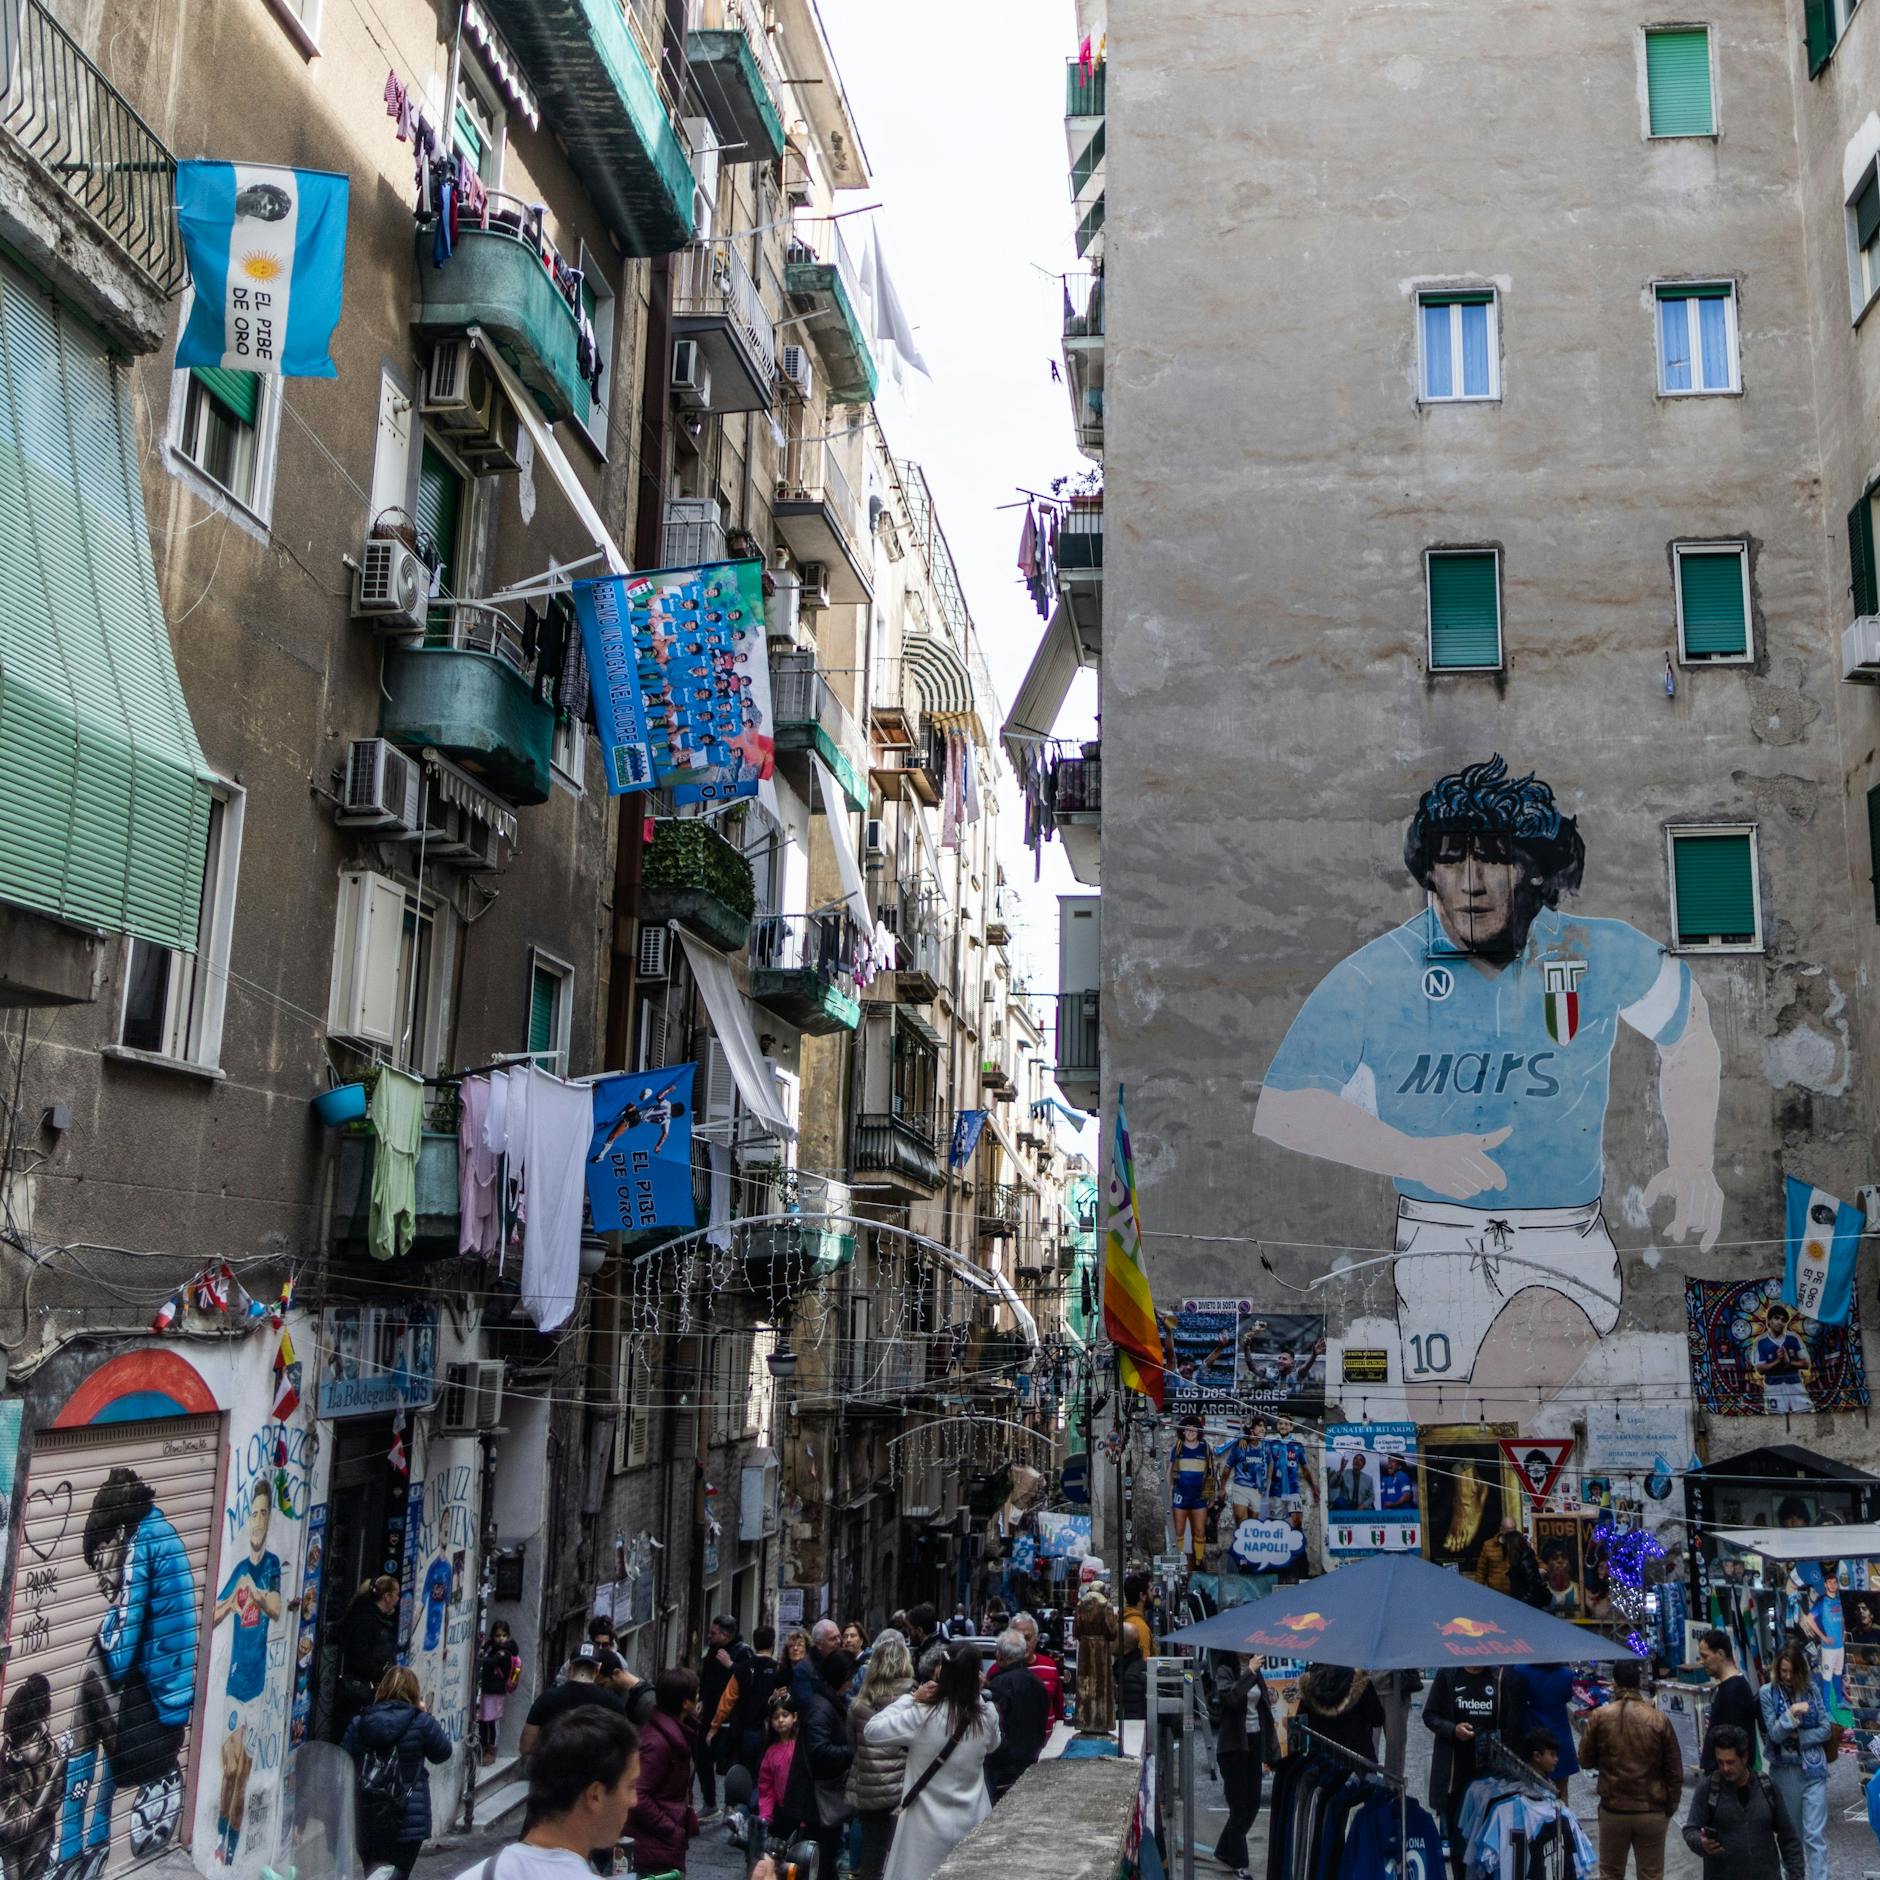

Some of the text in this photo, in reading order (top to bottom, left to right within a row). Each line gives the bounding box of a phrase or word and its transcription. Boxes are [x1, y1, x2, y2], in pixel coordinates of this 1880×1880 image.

[233, 287, 250, 356] DE ORO
[255, 291, 273, 361] EL PIBE
[592, 581, 620, 626] ABBIAMO
[600, 625, 623, 644] UN
[603, 643, 630, 682] SOGNO
[610, 682, 632, 704] NEL
[612, 705, 639, 744] CUORE
[1396, 1050, 1560, 1098] Mars
[610, 1153, 635, 1230] DE ORO
[632, 1150, 657, 1227] EL PIBE
[1198, 1301, 1217, 1310] DIVIETO
[1222, 1301, 1237, 1310] SOSTA
[1409, 1333, 1452, 1373] 10
[1175, 1388, 1288, 1400] LOS DOS MEJORES
[1171, 1402, 1279, 1416] SON ARGENTINOS
[1326, 1426, 1362, 1434] SCUSATE
[1173, 1492, 1183, 1504] 10
[1244, 1528, 1284, 1538] L'Oro di
[1243, 1542, 1289, 1553] NAPOLI!
[25, 1567, 58, 1603] PADRE
[1443, 1638, 1536, 1656] Red Bull
[1455, 1696, 1493, 1710] indeed
